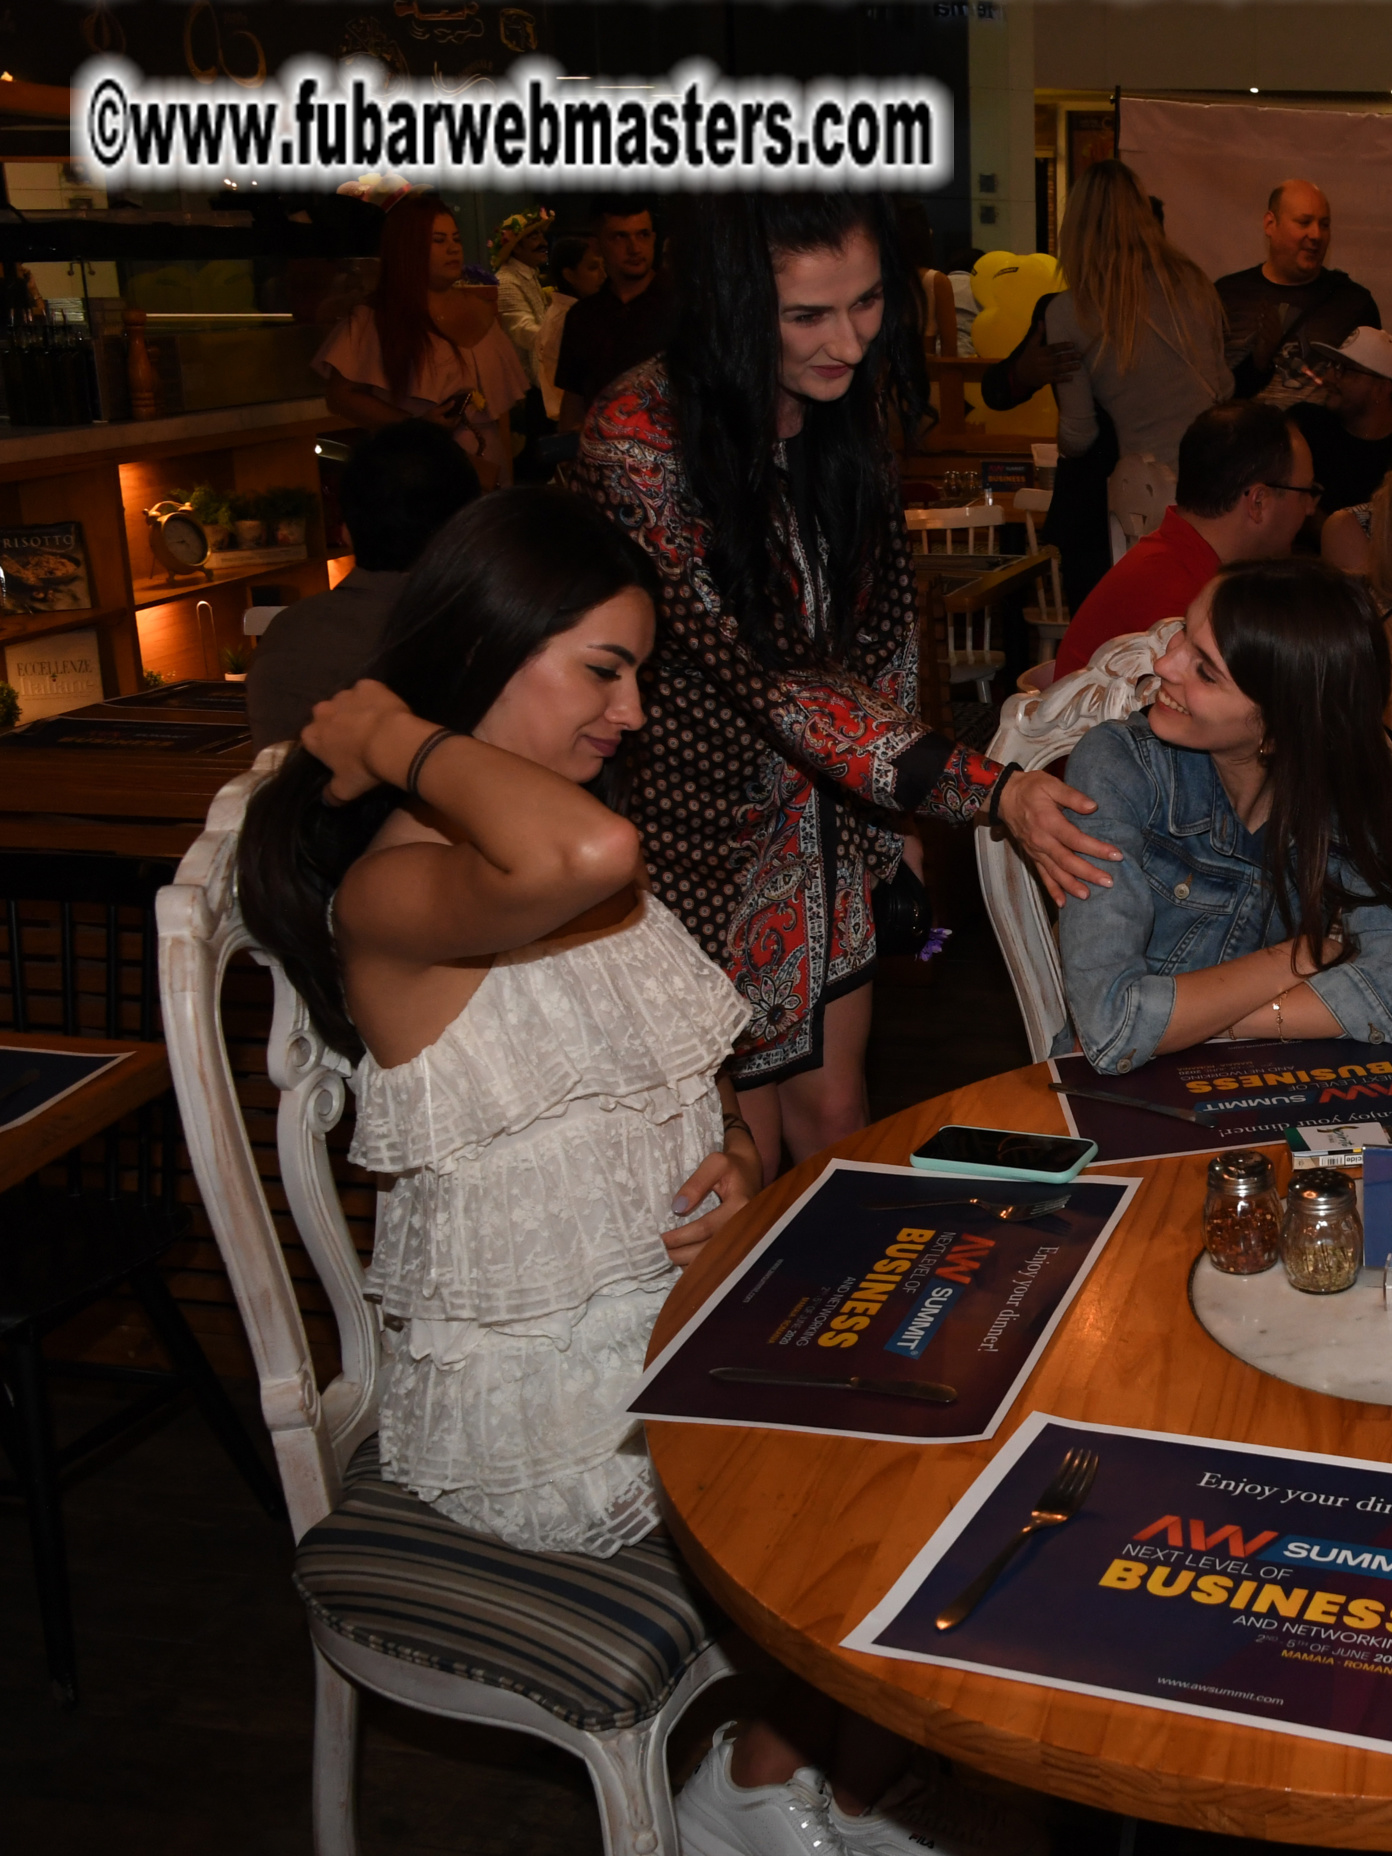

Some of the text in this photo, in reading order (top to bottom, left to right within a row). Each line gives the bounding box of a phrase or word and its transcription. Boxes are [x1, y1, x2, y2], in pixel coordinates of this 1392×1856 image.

[2, 534, 75, 549] RISOTTO
[17, 659, 93, 677] ECCELLENZE
[1180, 1064, 1295, 1081] AND NETWORKING
[1287, 1083, 1310, 1092] OF
[1311, 1076, 1356, 1089] LEVEL
[1298, 1114, 1342, 1128] your
[1219, 1122, 1291, 1138] dinner!
[902, 1231, 957, 1294] NEXT LEVEL OF
[817, 1227, 937, 1348] BUSINESS
[977, 1246, 1060, 1352] Enjoy your dinner!
[796, 1276, 857, 1347] AND NETWORKING
[779, 1330, 797, 1345] 2020
[1197, 1472, 1280, 1500] Enjoy
[1280, 1487, 1349, 1508] your
[1122, 1543, 1294, 1580] NEXT LEVEL OF
[1233, 1615, 1278, 1630] AND
[1281, 1649, 1335, 1666] MAMAIA
[1310, 1643, 1331, 1653] OF
[1331, 1647, 1371, 1661] JUNE
[1157, 1676, 1284, 1706] www.awsummit.com
[909, 1833, 935, 1849] FILA
